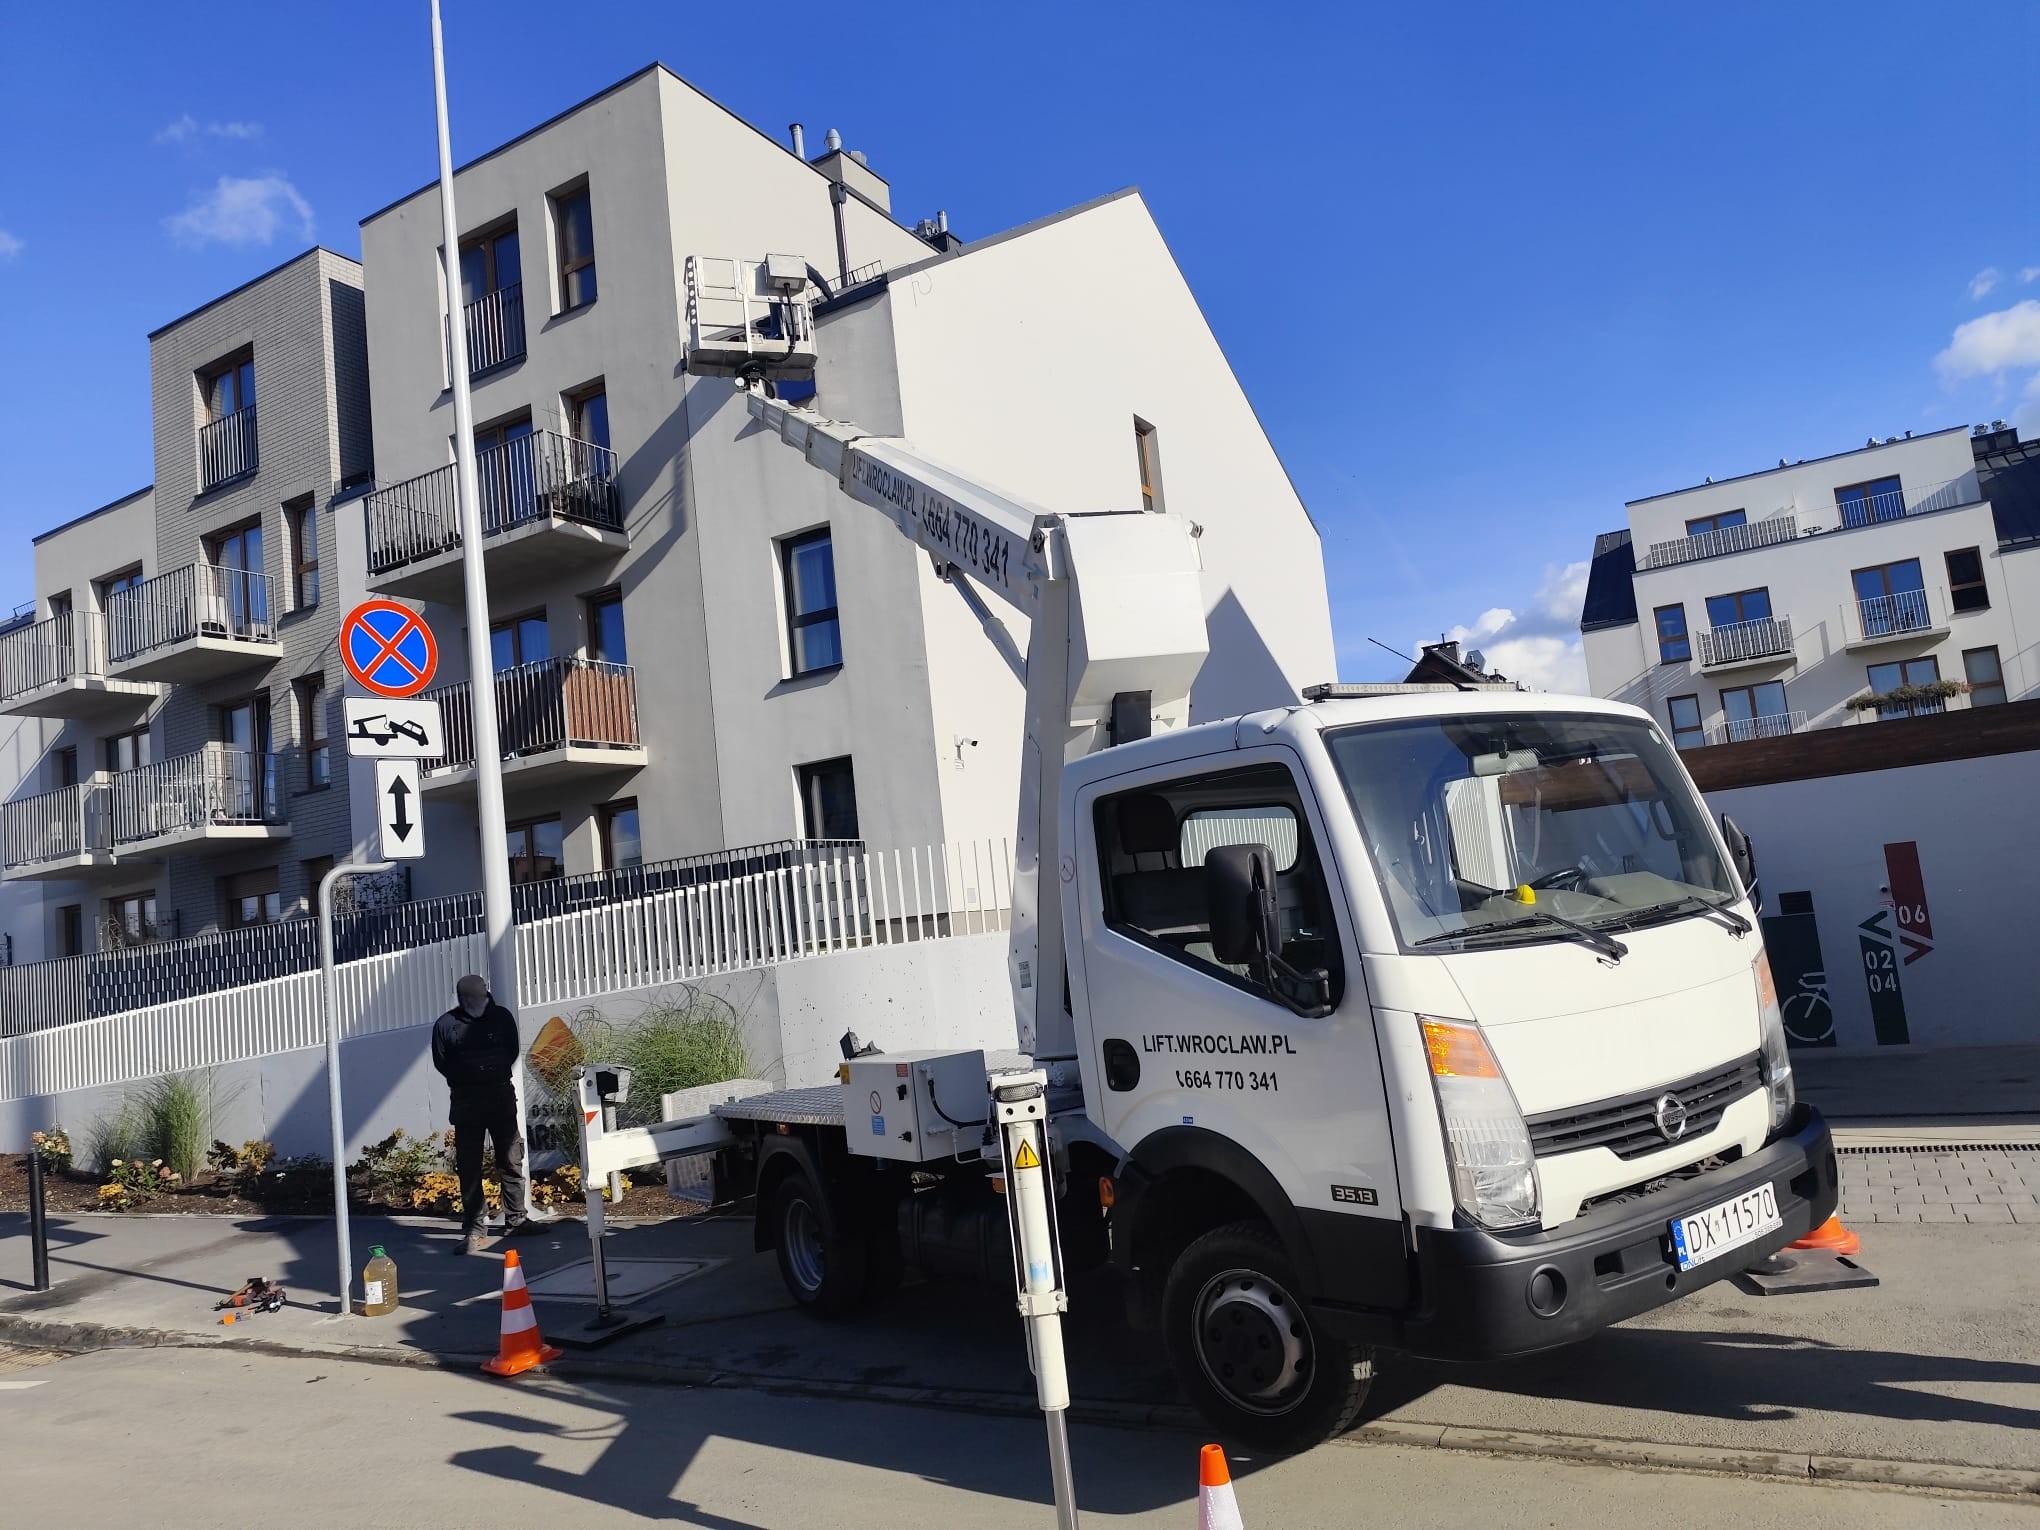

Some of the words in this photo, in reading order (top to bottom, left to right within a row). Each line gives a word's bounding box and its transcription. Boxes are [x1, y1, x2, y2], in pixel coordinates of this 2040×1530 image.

[927, 496, 950, 548] 664
[954, 510, 978, 566] 770
[982, 527, 1008, 588] 341
[1898, 904, 1926, 925] 06
[1865, 950, 1893, 970] 02
[1869, 973, 1897, 993] 04
[1142, 1034, 1297, 1055] LIFT.WROCLAW.PL
[1184, 1070, 1212, 1088] 664
[1215, 1071, 1244, 1090] 770
[1249, 1071, 1278, 1091] 341
[1335, 1187, 1374, 1203] 35.13
[1687, 1212, 1716, 1254] DX
[1721, 1188, 1774, 1239] 11570
[1677, 1246, 1687, 1257] PL
